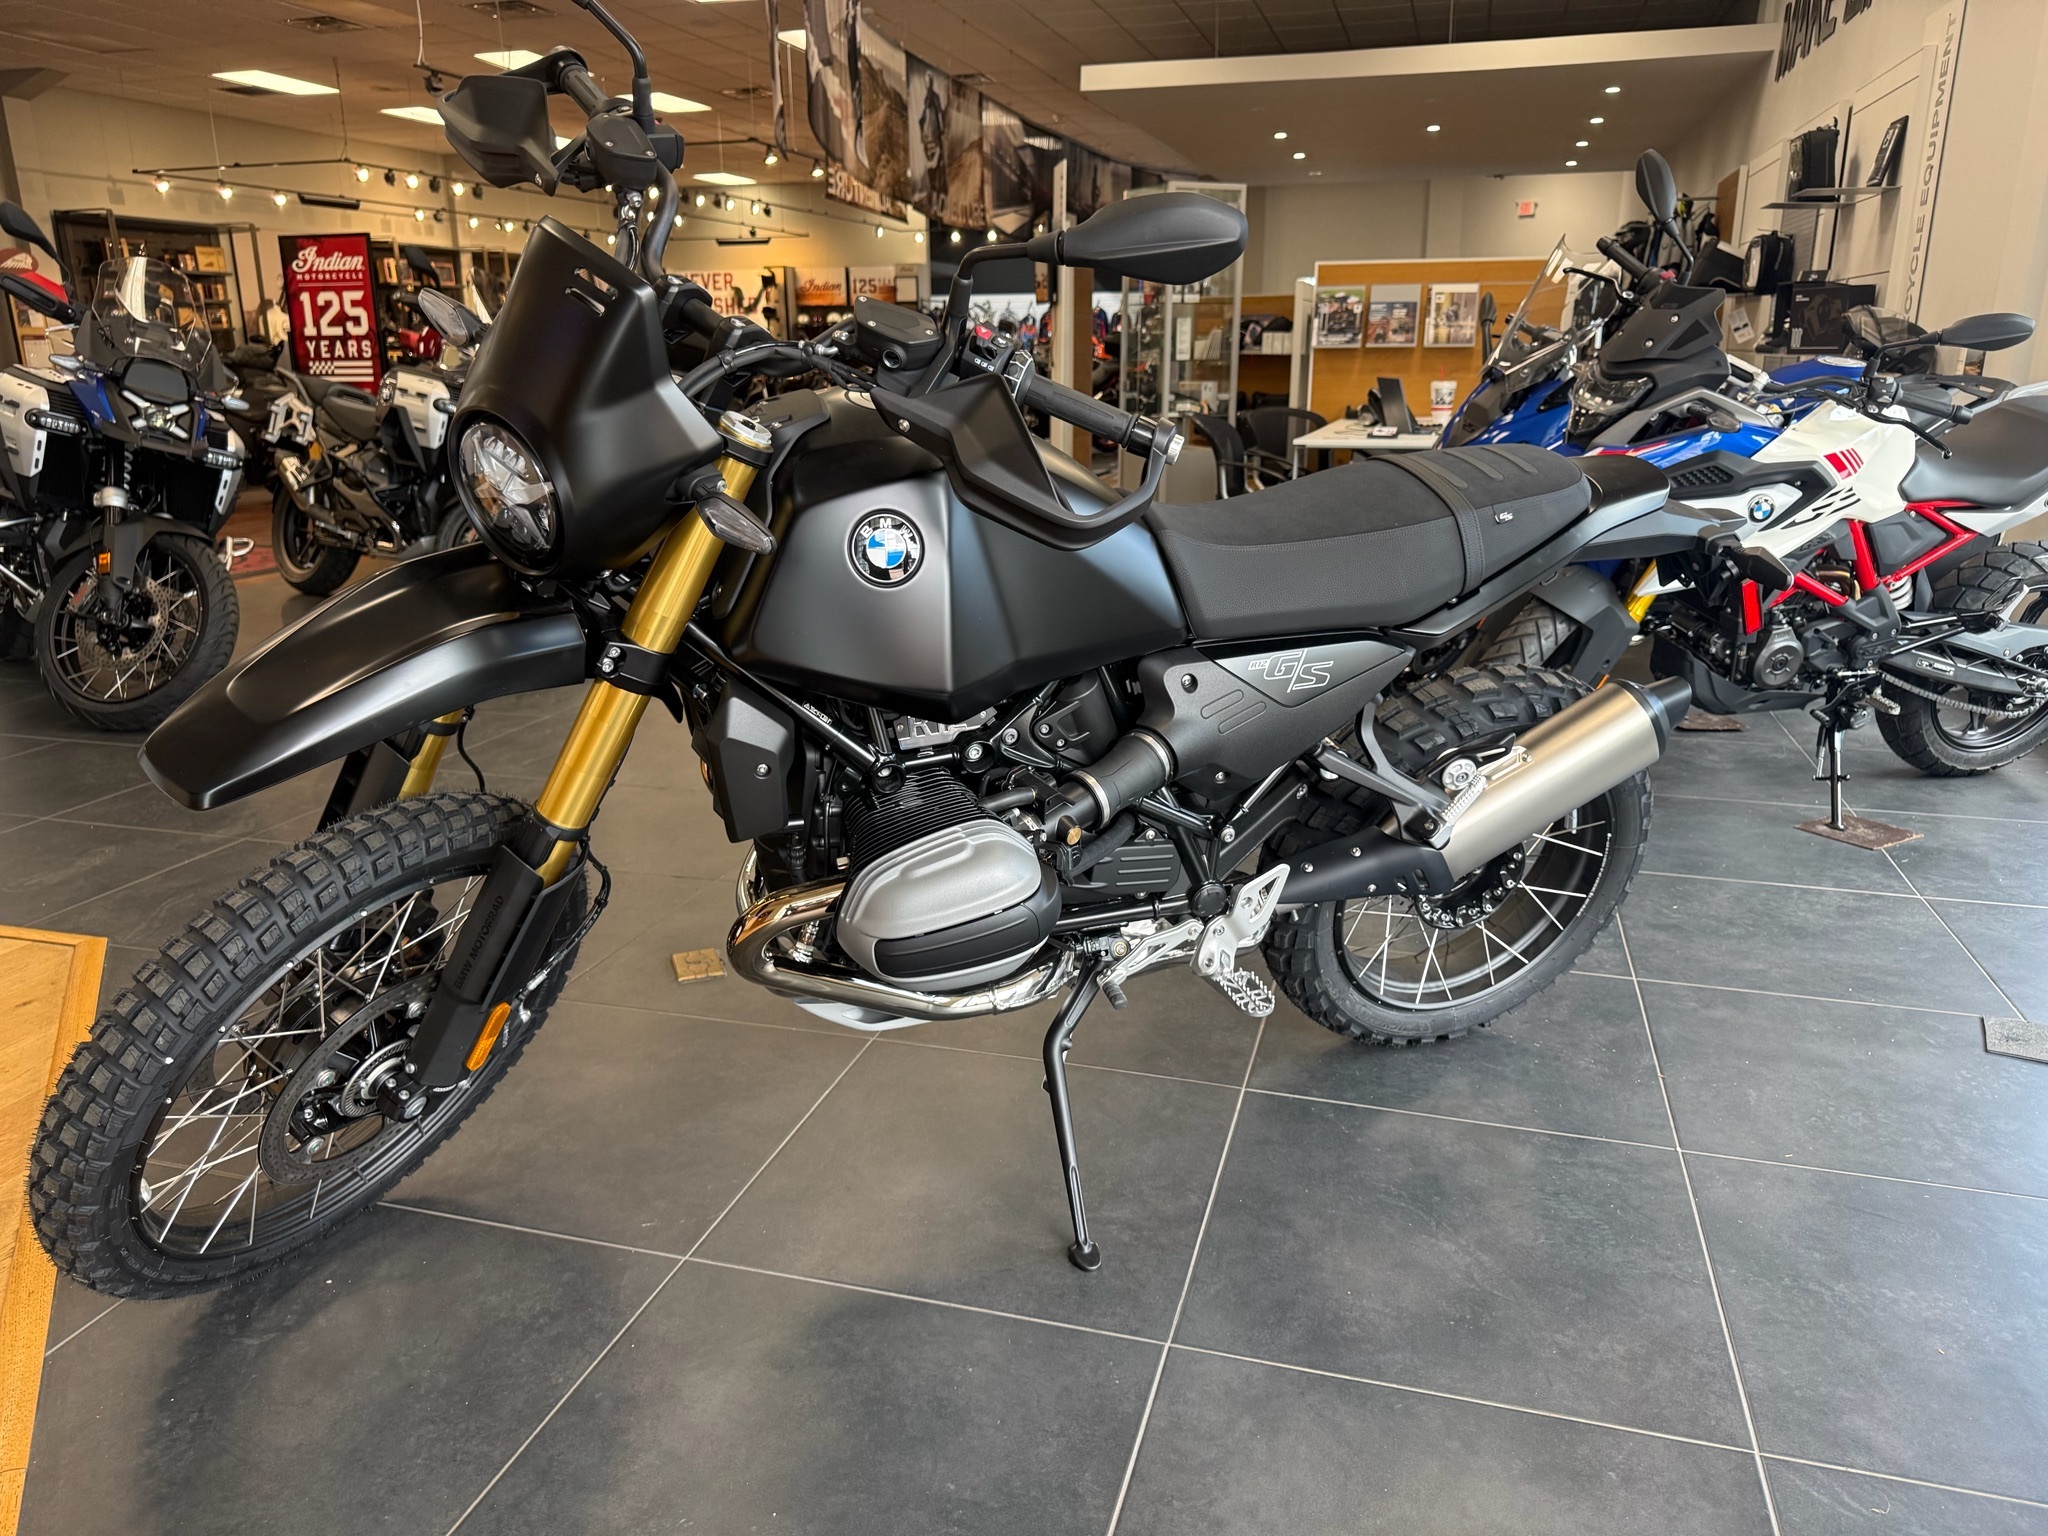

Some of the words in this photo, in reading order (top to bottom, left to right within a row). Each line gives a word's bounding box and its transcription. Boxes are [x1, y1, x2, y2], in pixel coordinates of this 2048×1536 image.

[1919, 12, 1957, 207] EQUIPMENT
[291, 246, 364, 273] Indian
[296, 272, 364, 281] MOTORCYCLE
[800, 278, 842, 296] Indian
[852, 277, 878, 295] 125
[300, 290, 369, 337] 125
[305, 339, 373, 359] YEARS
[860, 517, 914, 539] BMW
[454, 960, 473, 990] BMW
[468, 895, 504, 961] MOTORRAD
